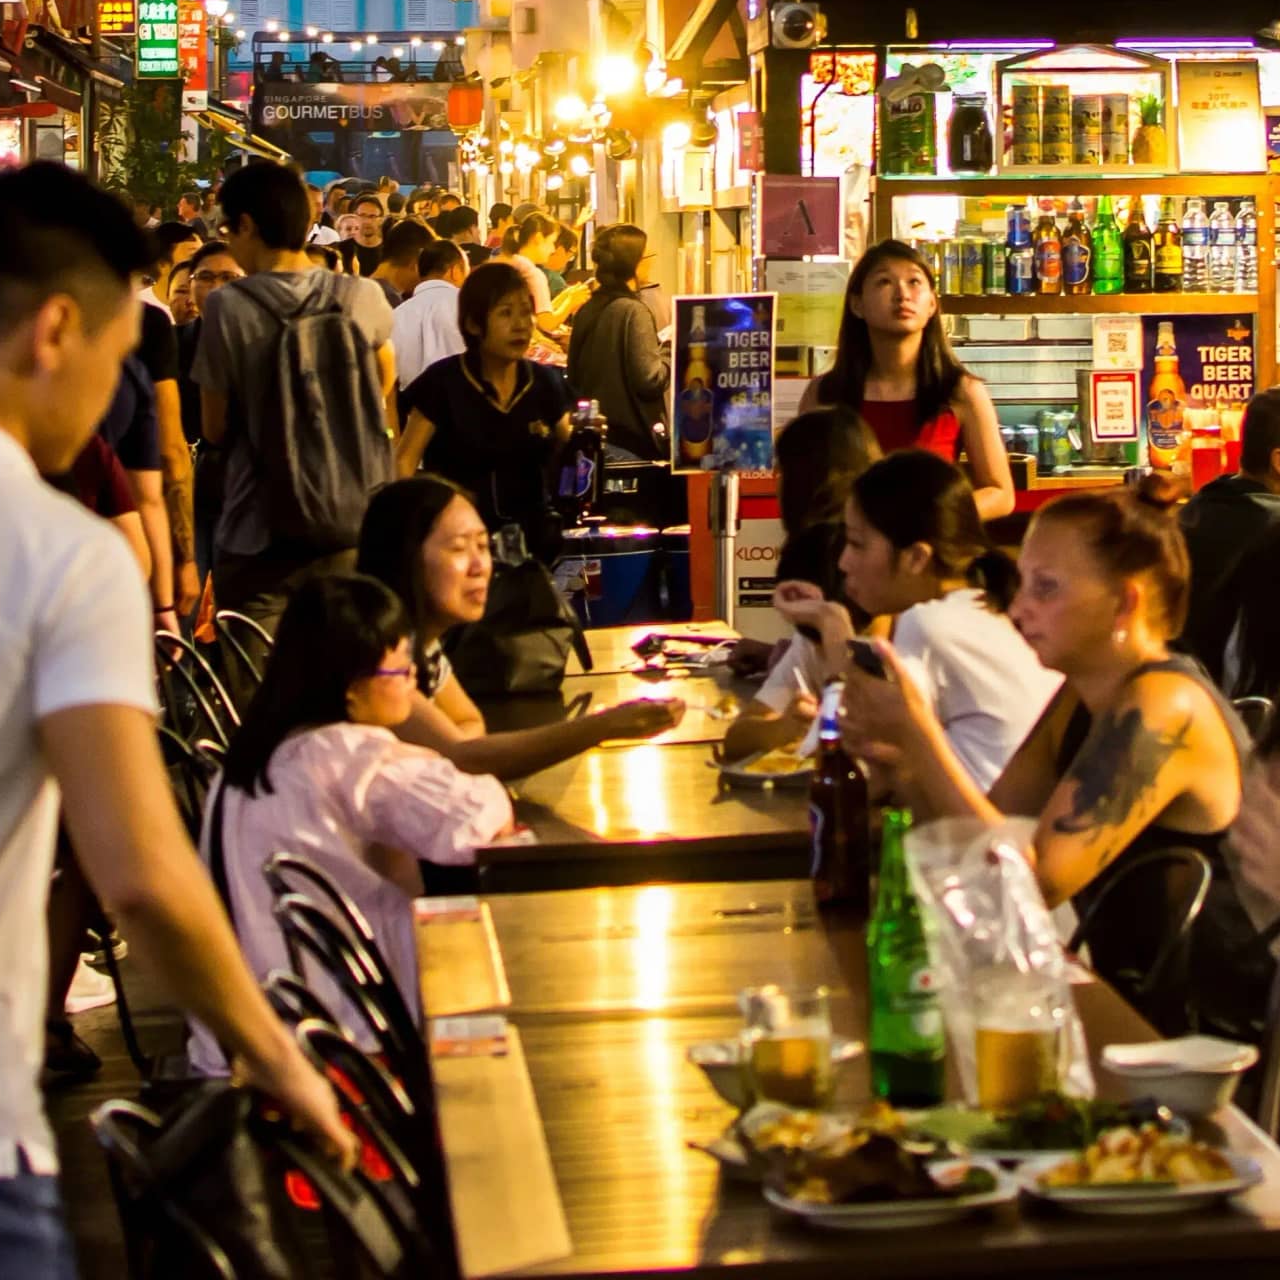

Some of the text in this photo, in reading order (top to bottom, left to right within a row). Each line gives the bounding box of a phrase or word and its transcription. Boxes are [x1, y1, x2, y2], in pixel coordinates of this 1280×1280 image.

[262, 105, 383, 120] GOURMETBUS
[725, 331, 769, 348] TIGER
[728, 351, 769, 368] BEER
[1197, 346, 1252, 363] TIGER
[718, 371, 769, 389] QUART
[1203, 365, 1252, 381] BEER
[1190, 384, 1252, 400] QUART
